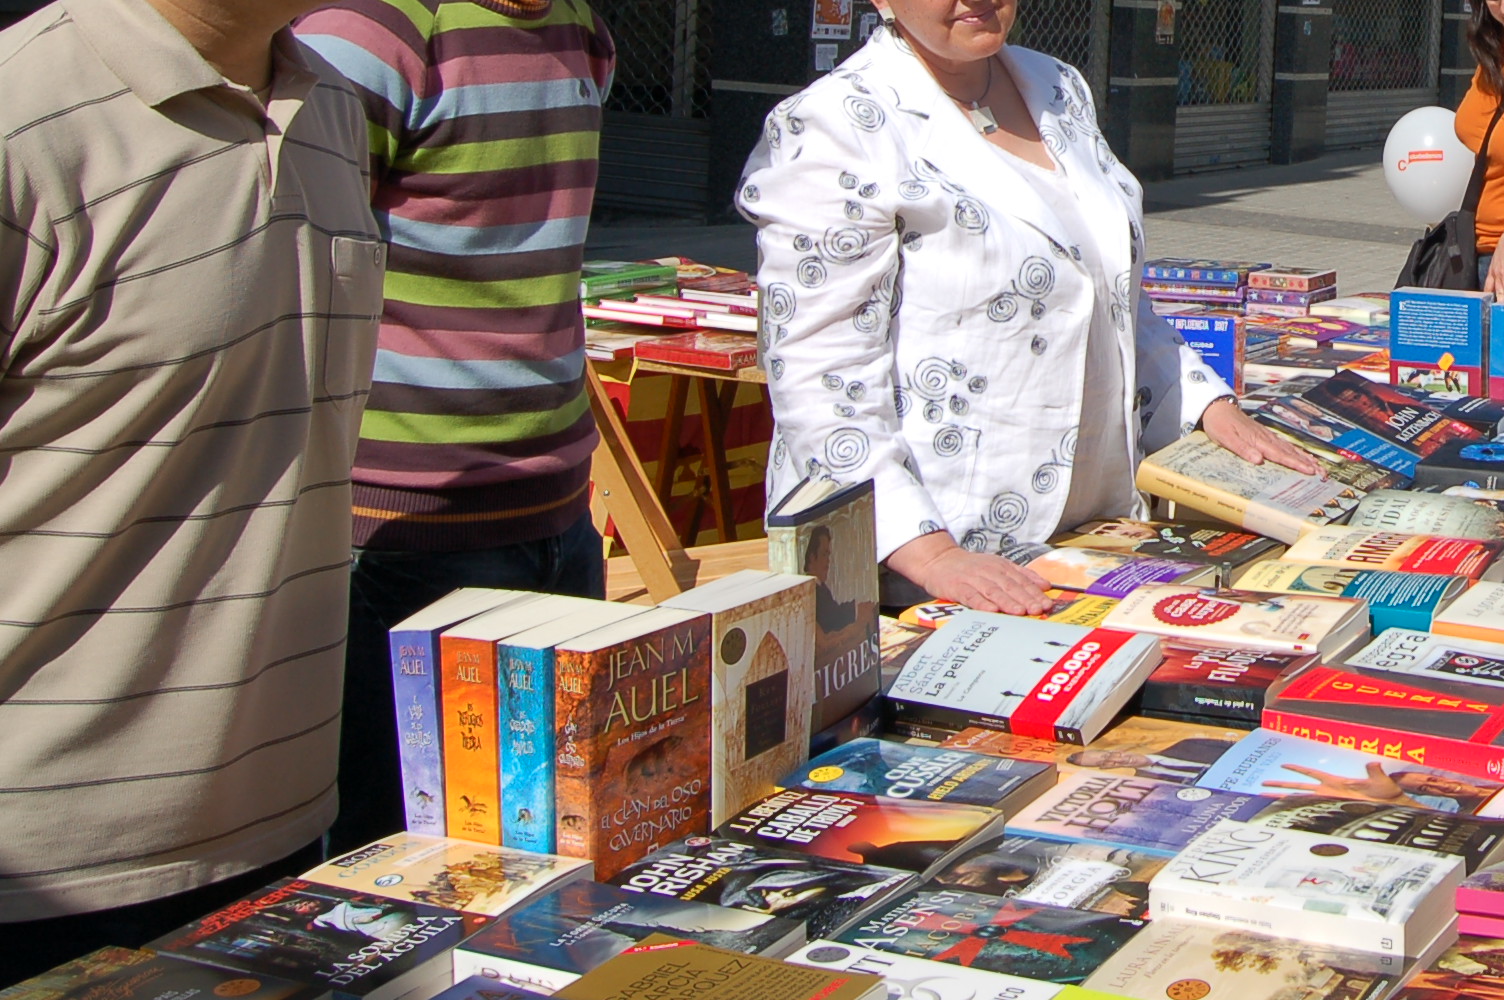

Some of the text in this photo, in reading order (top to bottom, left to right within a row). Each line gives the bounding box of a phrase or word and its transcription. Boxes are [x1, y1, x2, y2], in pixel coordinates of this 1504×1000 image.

[1386, 407, 1420, 429] JOHN
[401, 660, 428, 676] AUEL
[607, 638, 664, 692] JEAN
[910, 620, 986, 694] Sánchez Piñol
[925, 625, 999, 697] La pell freda
[1036, 641, 1101, 701] 130.000
[1374, 633, 1431, 668] egra
[457, 666, 482, 684] AUEL
[509, 674, 534, 692] AUEL
[559, 676, 584, 694] AUEL
[896, 653, 932, 691] Albert
[604, 667, 699, 734] AUEL
[1332, 680, 1489, 713] GUERRA
[617, 735, 630, 747] Los
[1236, 737, 1283, 777] RUBIANES
[1290, 726, 1426, 765] GUERRA
[884, 756, 929, 781] CLIVE
[886, 751, 969, 798] CUSSLER
[601, 816, 611, 829] EL
[614, 796, 651, 825] CLAN
[672, 779, 702, 804] OSO
[756, 794, 841, 839] CABALLO
[1035, 776, 1118, 824] VICTORIA
[1065, 778, 1157, 831] HOLT
[1181, 802, 1226, 834] LA LUNA
[609, 806, 693, 851] CAVERNARIO
[785, 827, 820, 843] DE
[803, 802, 857, 829] TROYA
[345, 845, 391, 867] NOAH
[620, 853, 696, 893] JOHN
[651, 842, 755, 897] RISHAM
[1180, 825, 1275, 886] KING
[1049, 866, 1103, 903] ORGIA
[852, 891, 965, 953] ASENSI
[315, 914, 439, 978] LA SOMBRA
[328, 914, 464, 986] DEL ÁGUILA
[648, 968, 706, 1000] ARCIA
[674, 958, 754, 1000] ARQUEZ
